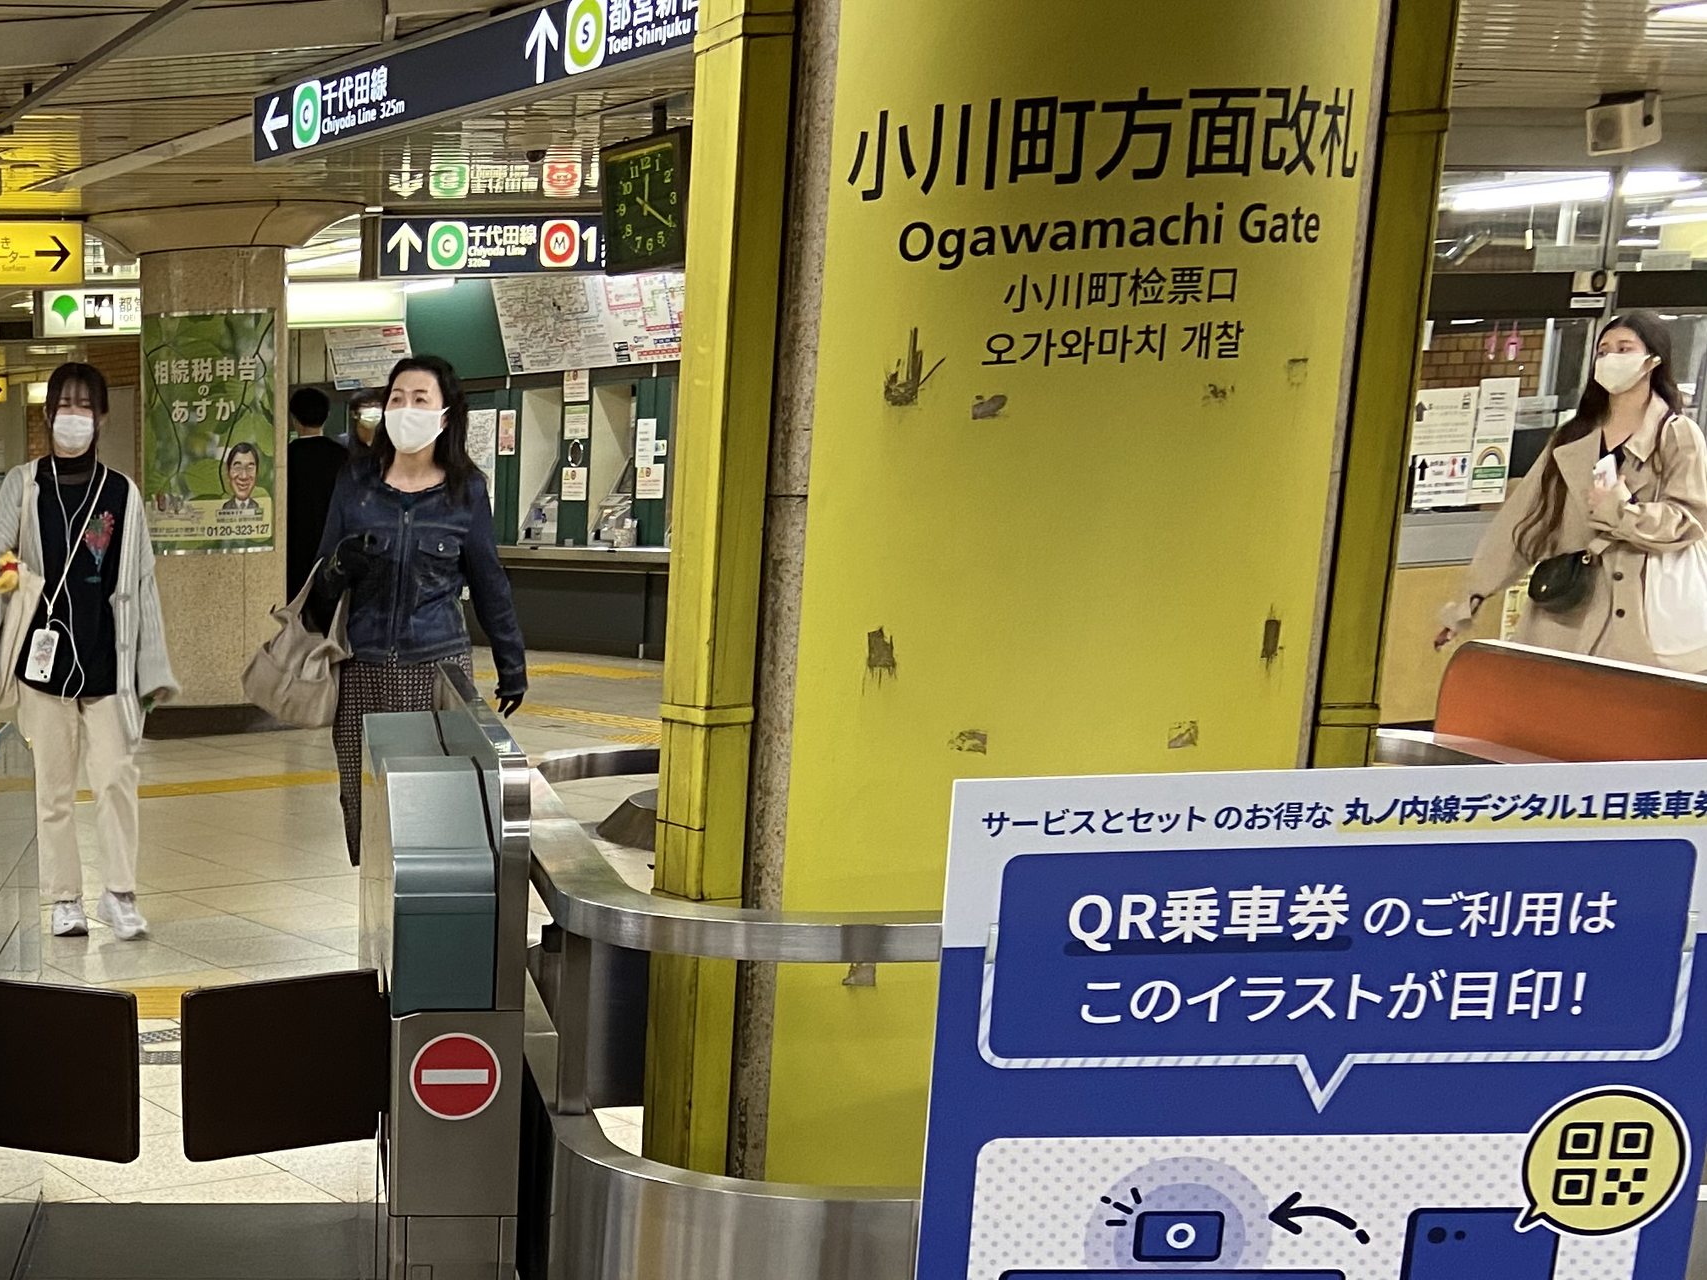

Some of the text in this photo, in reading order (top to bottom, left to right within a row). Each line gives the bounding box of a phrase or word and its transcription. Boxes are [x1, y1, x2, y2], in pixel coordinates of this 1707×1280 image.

[607, 16, 691, 55] Toei Shinjuku
[322, 65, 388, 115] 千代田線
[321, 98, 405, 136] Chiyoda Line 325m
[847, 85, 1359, 202] 小川町方面改札
[640, 156, 651, 170] 12
[664, 170, 671, 183] 2
[622, 181, 632, 195] 10
[670, 191, 677, 205] 3
[619, 203, 626, 216] 9
[468, 225, 537, 247] 千代田線
[625, 224, 632, 236] 8
[657, 231, 665, 244] 5
[898, 202, 1321, 271] Ogawamachi Gate
[506, 245, 527, 256] Line
[581, 226, 597, 263] 1
[635, 236, 642, 249] 7
[646, 238, 653, 251] 6
[1003, 267, 1239, 313] 小川町检票口
[982, 320, 1245, 366] 오가와마치 개찰
[154, 356, 258, 386] 相続税申告
[198, 385, 209, 396] の
[171, 398, 237, 424] あすか
[207, 524, 270, 537] 0120-323-127
[981, 801, 1335, 838] サービスとセットのお得な
[1067, 883, 1619, 954] QR乗車券のご利用は
